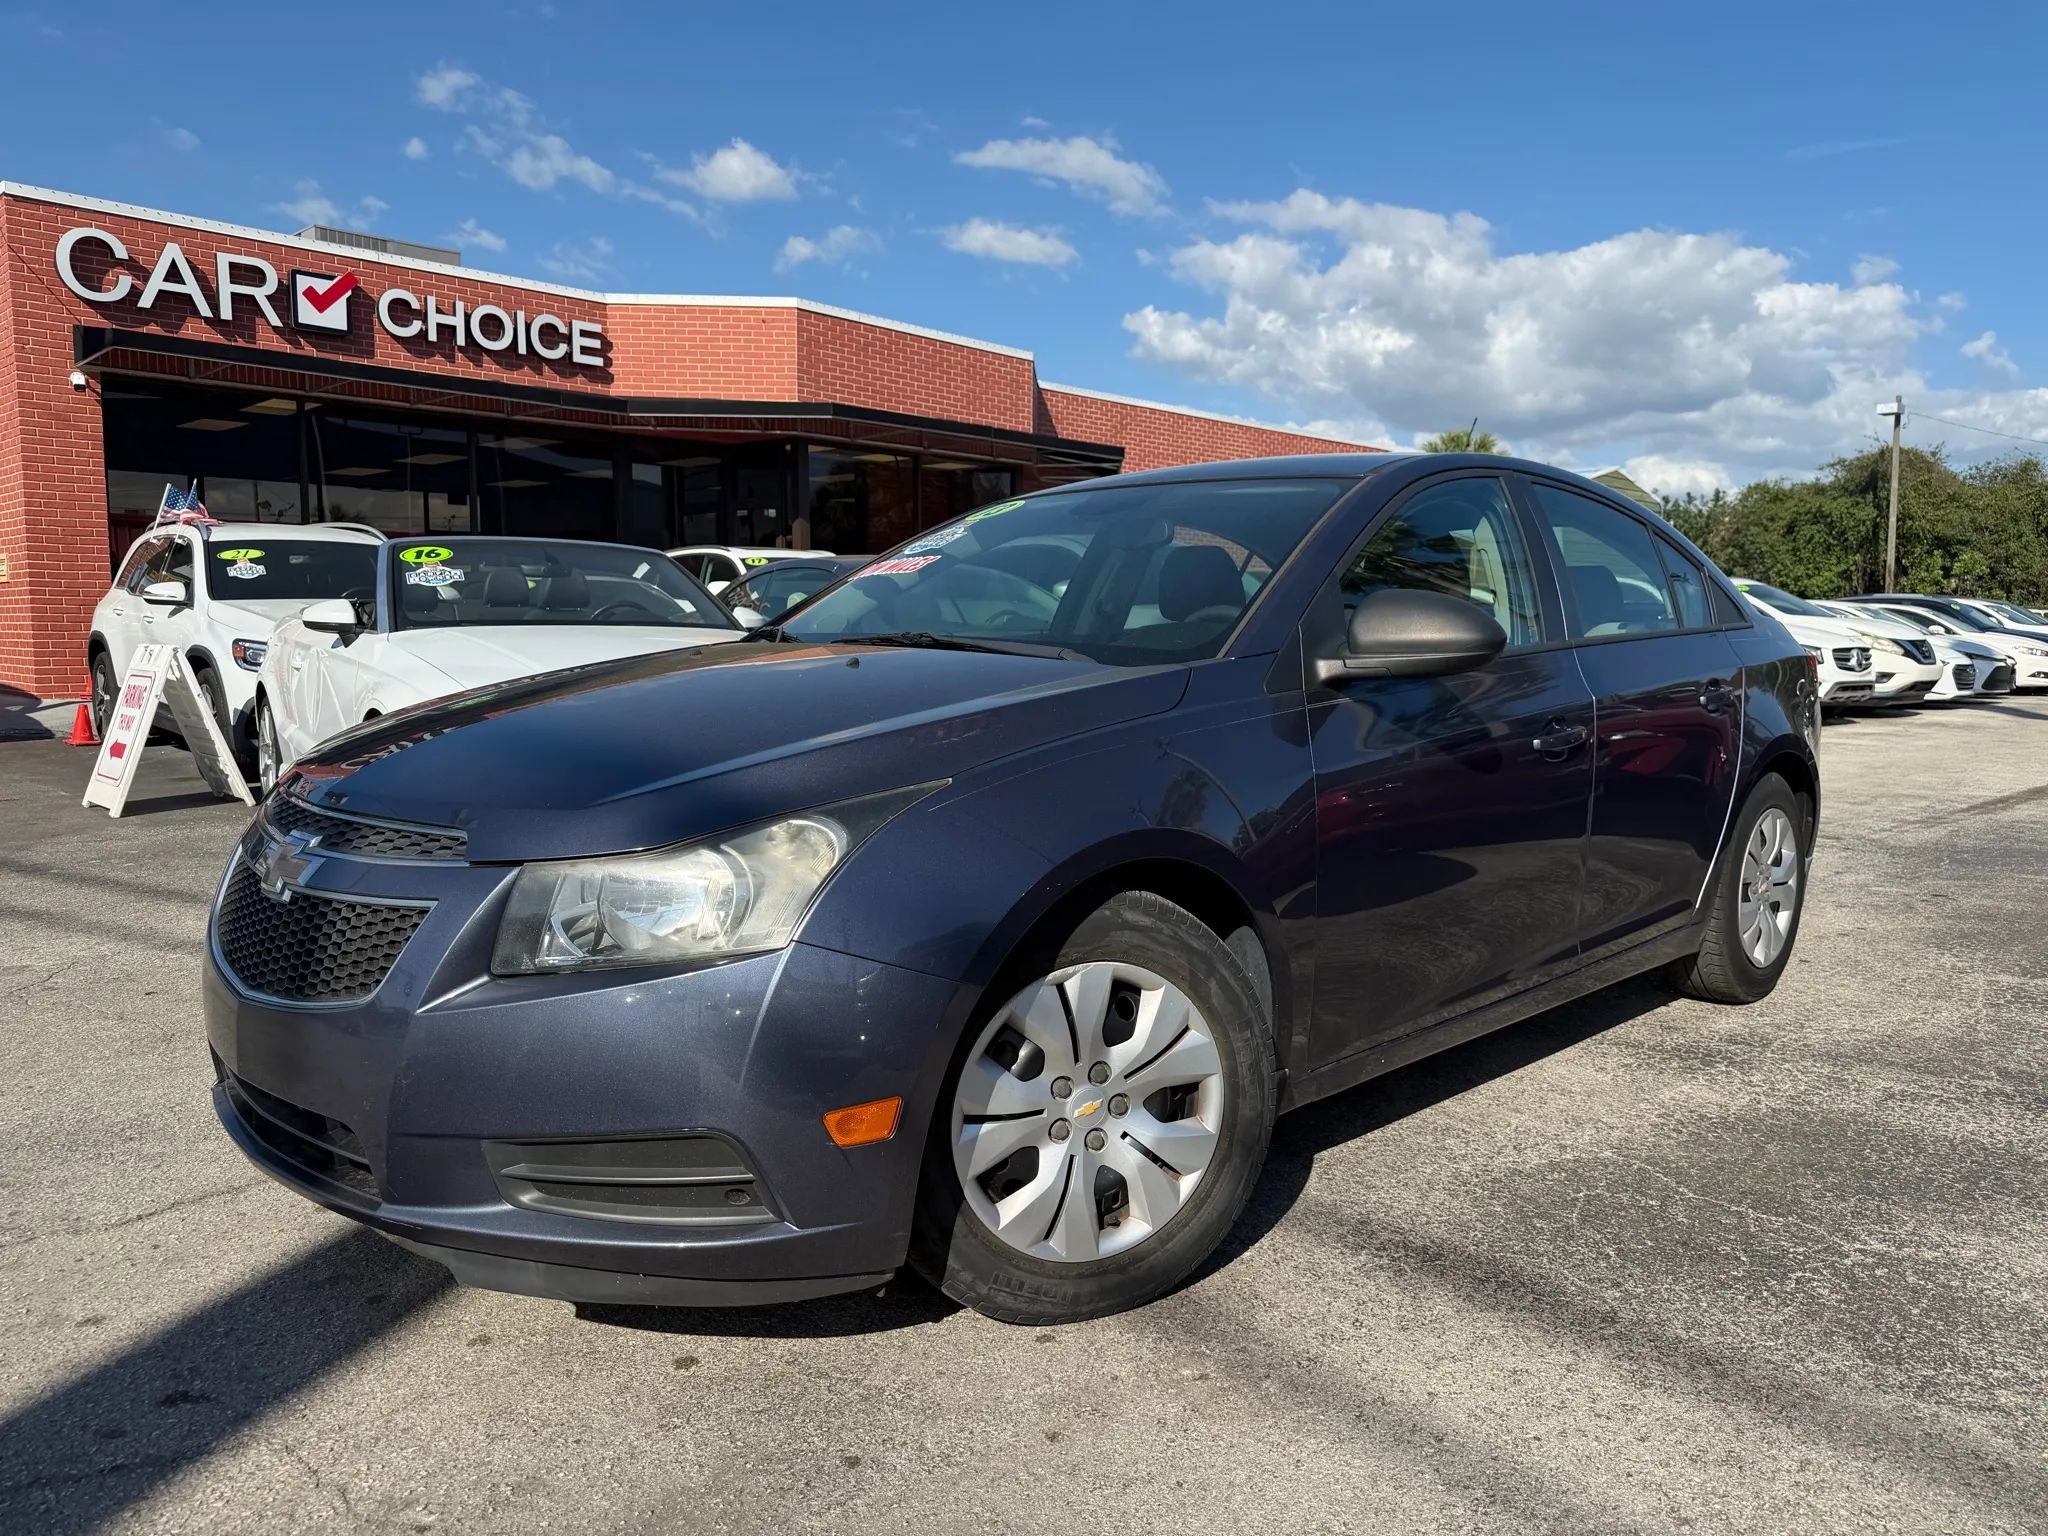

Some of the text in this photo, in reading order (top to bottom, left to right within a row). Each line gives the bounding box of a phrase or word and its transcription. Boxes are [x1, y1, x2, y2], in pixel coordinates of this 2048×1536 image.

[54, 227, 605, 367] CAR CHOICE
[231, 550, 250, 558] 21
[414, 549, 442, 560] 16
